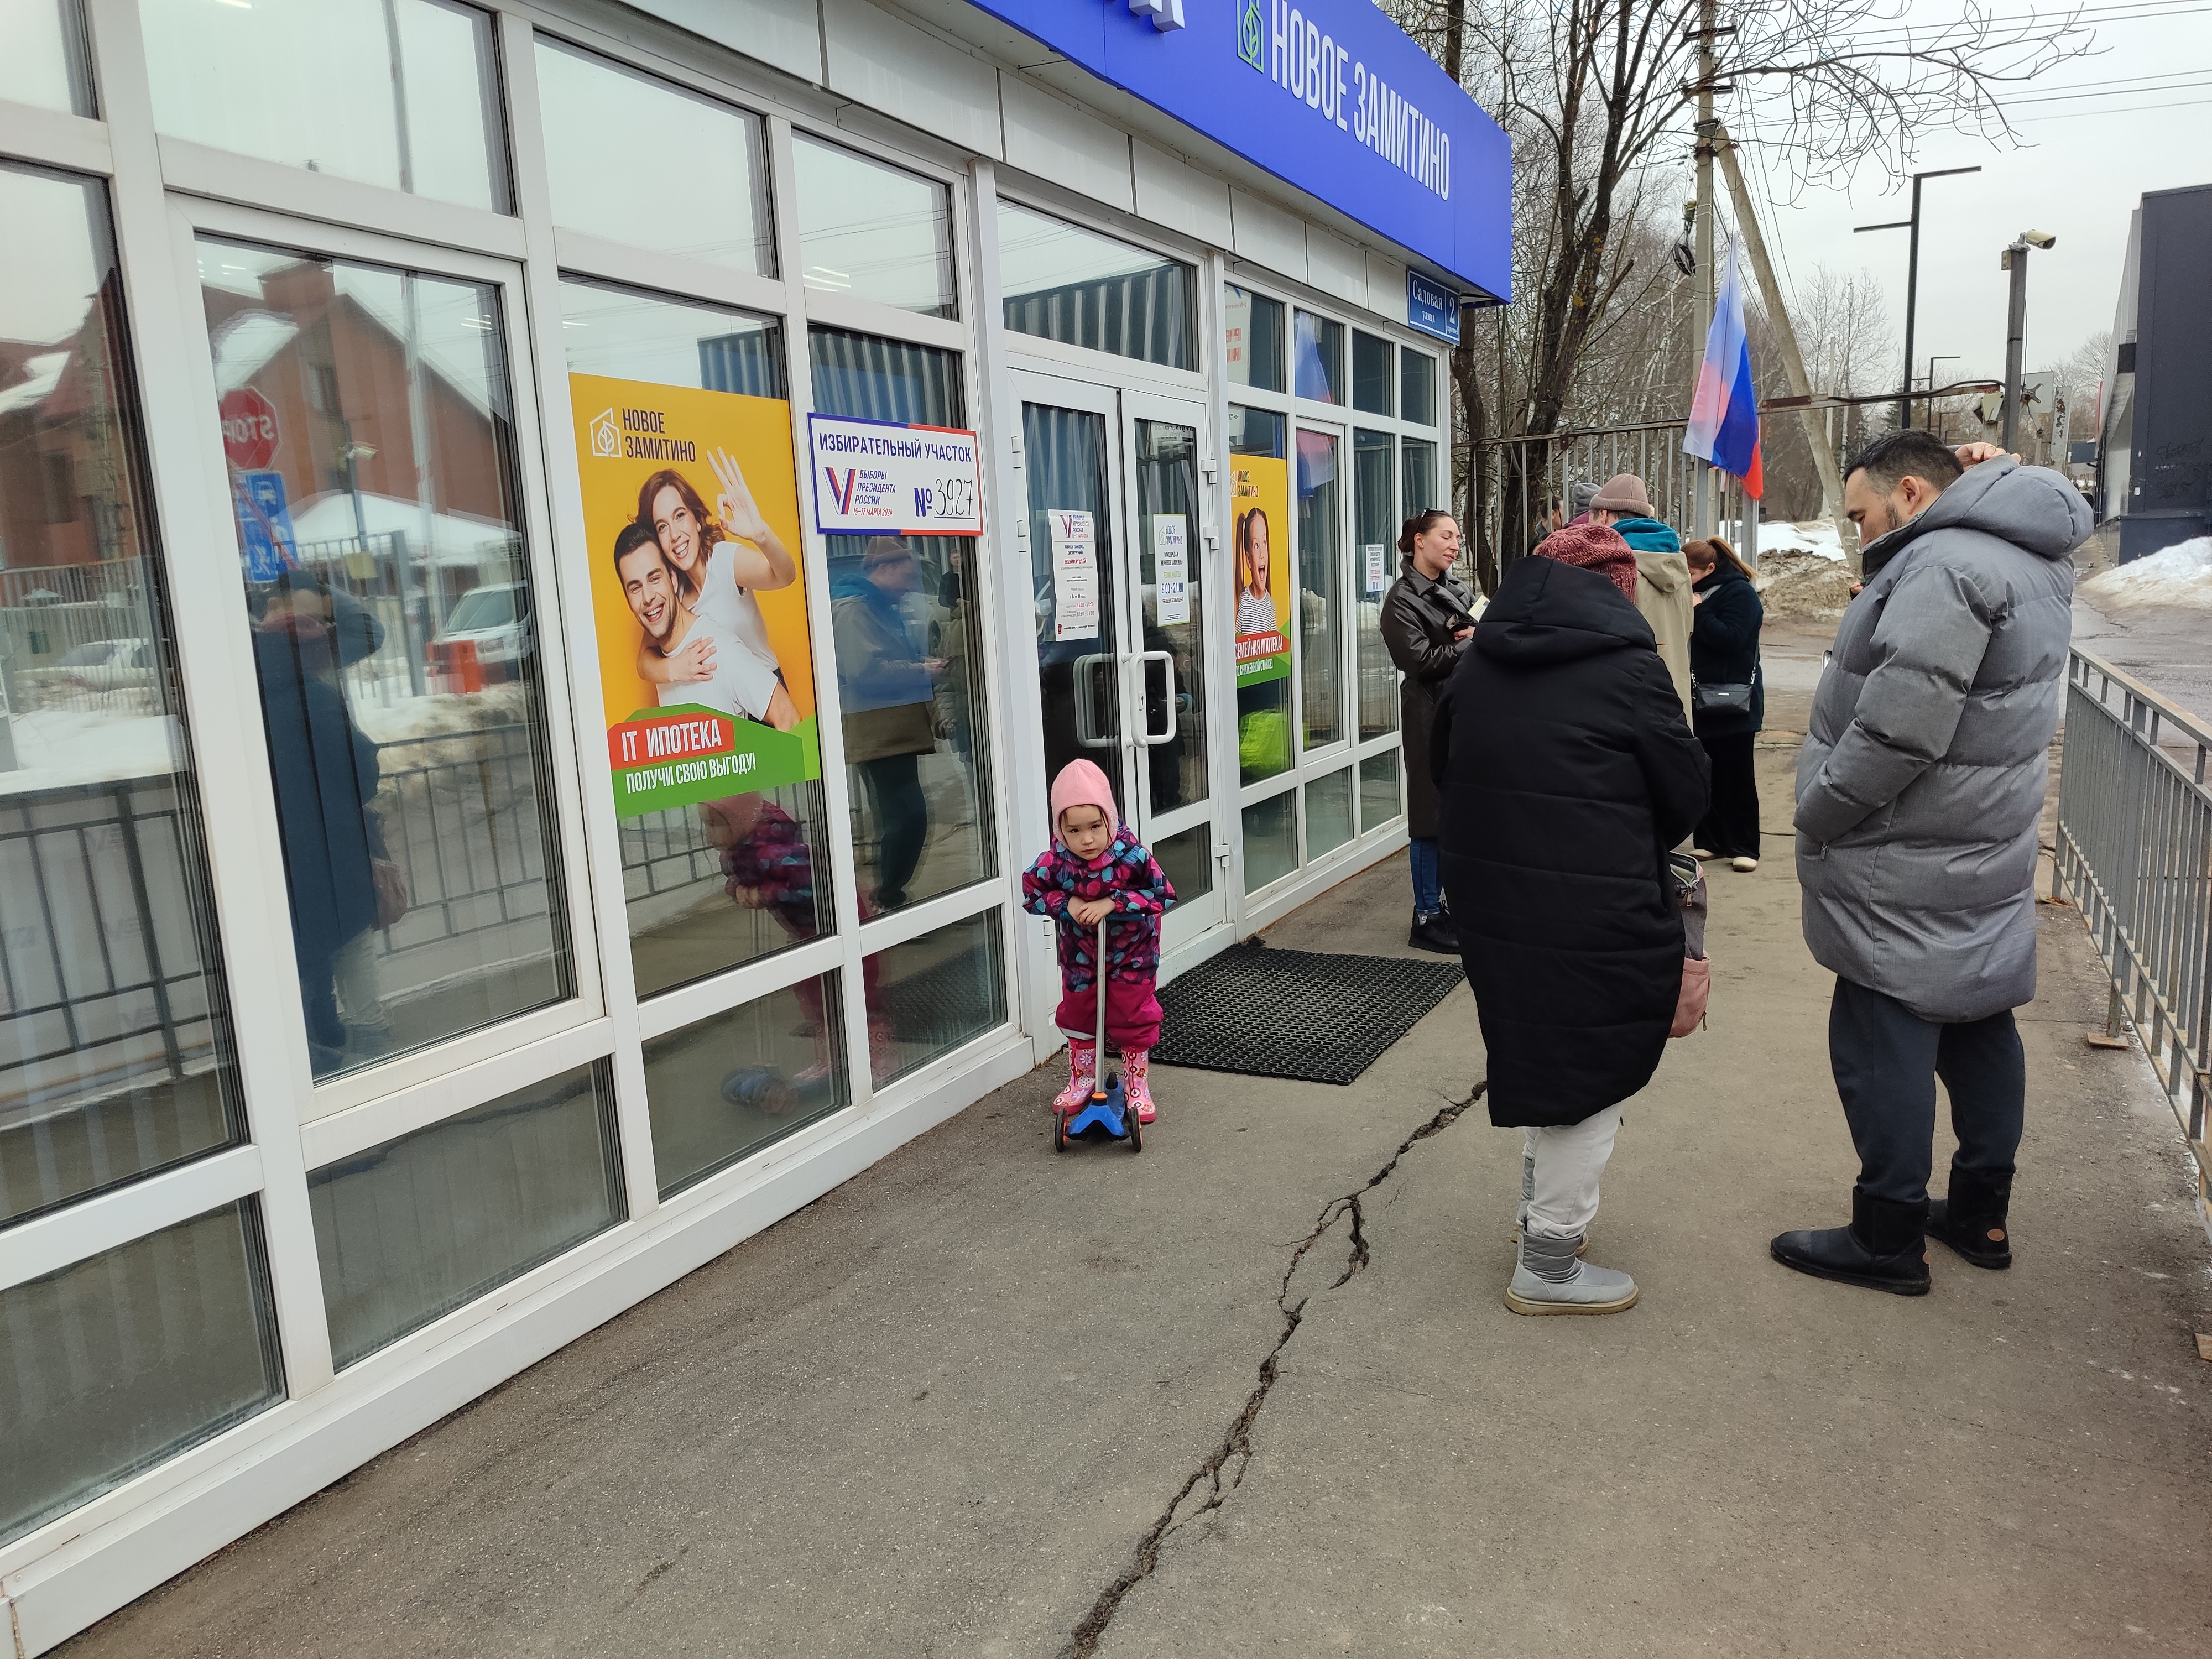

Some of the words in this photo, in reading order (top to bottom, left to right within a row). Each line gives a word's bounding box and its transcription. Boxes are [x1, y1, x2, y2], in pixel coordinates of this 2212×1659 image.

[1271, 0, 1349, 132] НОВОЕ
[1354, 61, 1450, 201] ЗАМИТИНО
[1412, 279, 1443, 311] Садовая
[1422, 310, 1436, 324] улица
[1449, 297, 1455, 325] 2
[622, 408, 666, 434] НОВОЕ
[625, 435, 696, 462] ЗАМИТИНО
[818, 432, 922, 459] ИЗБИРАТЕЛЬНЫЙ
[924, 443, 972, 463] УЧАСТОК
[857, 482, 896, 494] ПРЕЗИДЕНТА
[859, 469, 888, 481] ВЫБОРЫ
[854, 494, 880, 505] РОССИИ
[914, 488, 933, 517] №
[935, 478, 973, 517] 3927
[866, 507, 882, 517] МАРТА
[882, 508, 893, 517] 2024
[1161, 583, 1170, 594] 9.00
[1173, 582, 1183, 593] 21.00
[1235, 637, 1260, 660] СЕМЕЙНАЯ
[1260, 635, 1283, 655] ИПОТЕКА!
[1240, 659, 1260, 676] СНИЖЕННОЙ
[646, 719, 722, 758] ИПОТЕКА
[625, 766, 674, 794] ПОЛУЧИ
[675, 760, 707, 784] СВОЮ
[709, 752, 757, 778] ВЫГОДУ!
